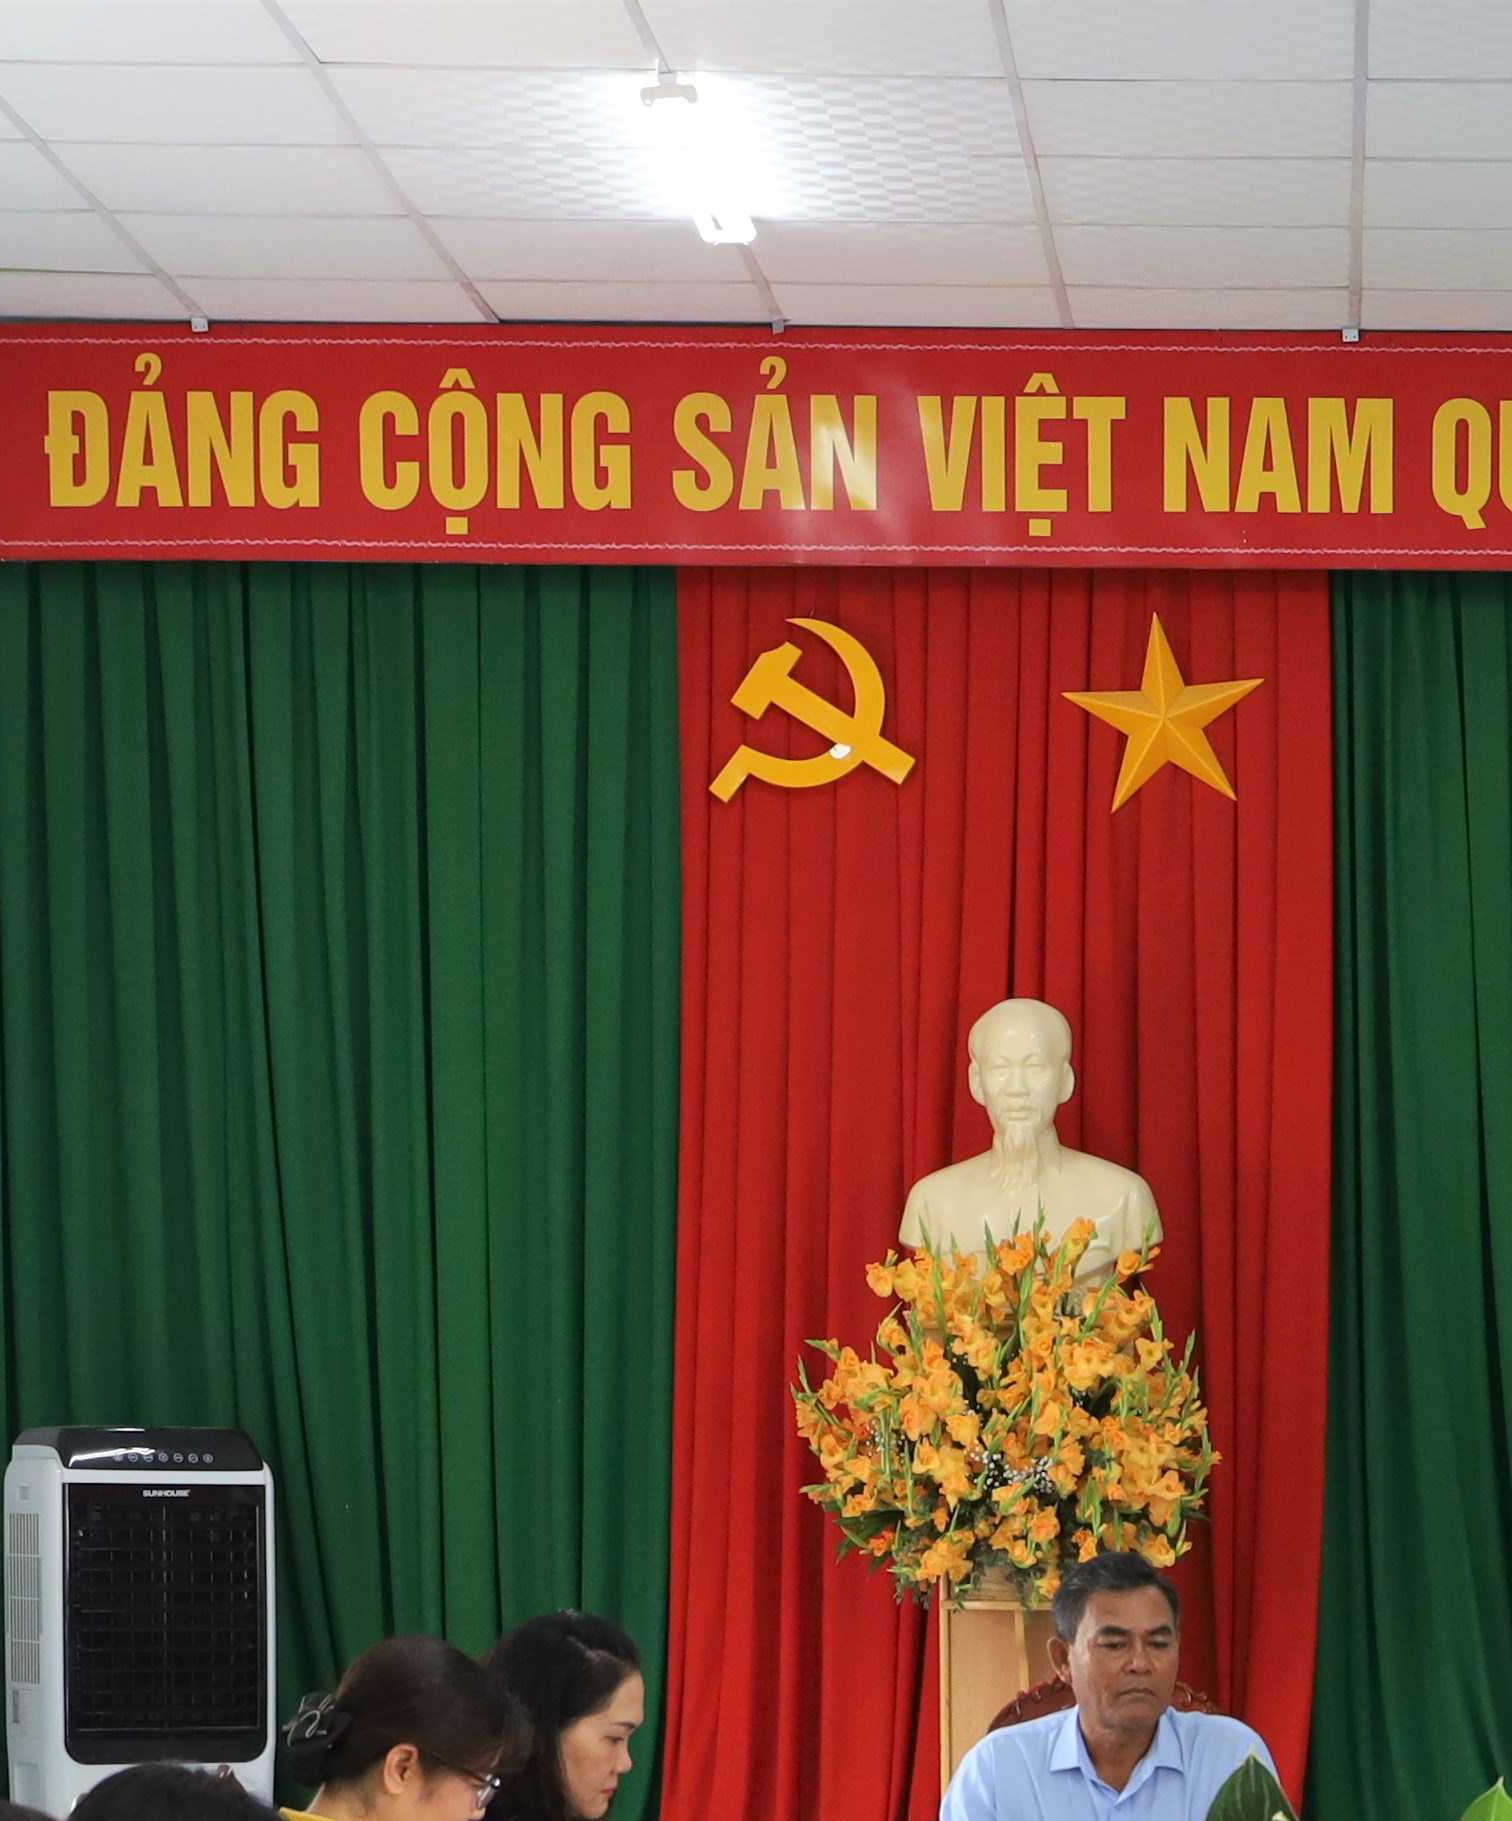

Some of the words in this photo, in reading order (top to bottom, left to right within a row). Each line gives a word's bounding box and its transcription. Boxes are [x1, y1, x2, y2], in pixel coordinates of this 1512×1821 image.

[45, 353, 319, 509] ĐẢNG
[360, 367, 632, 534] CỘNG
[671, 357, 878, 511] SẢN
[919, 374, 1126, 535] VIỆT
[1163, 395, 1393, 514] NAM
